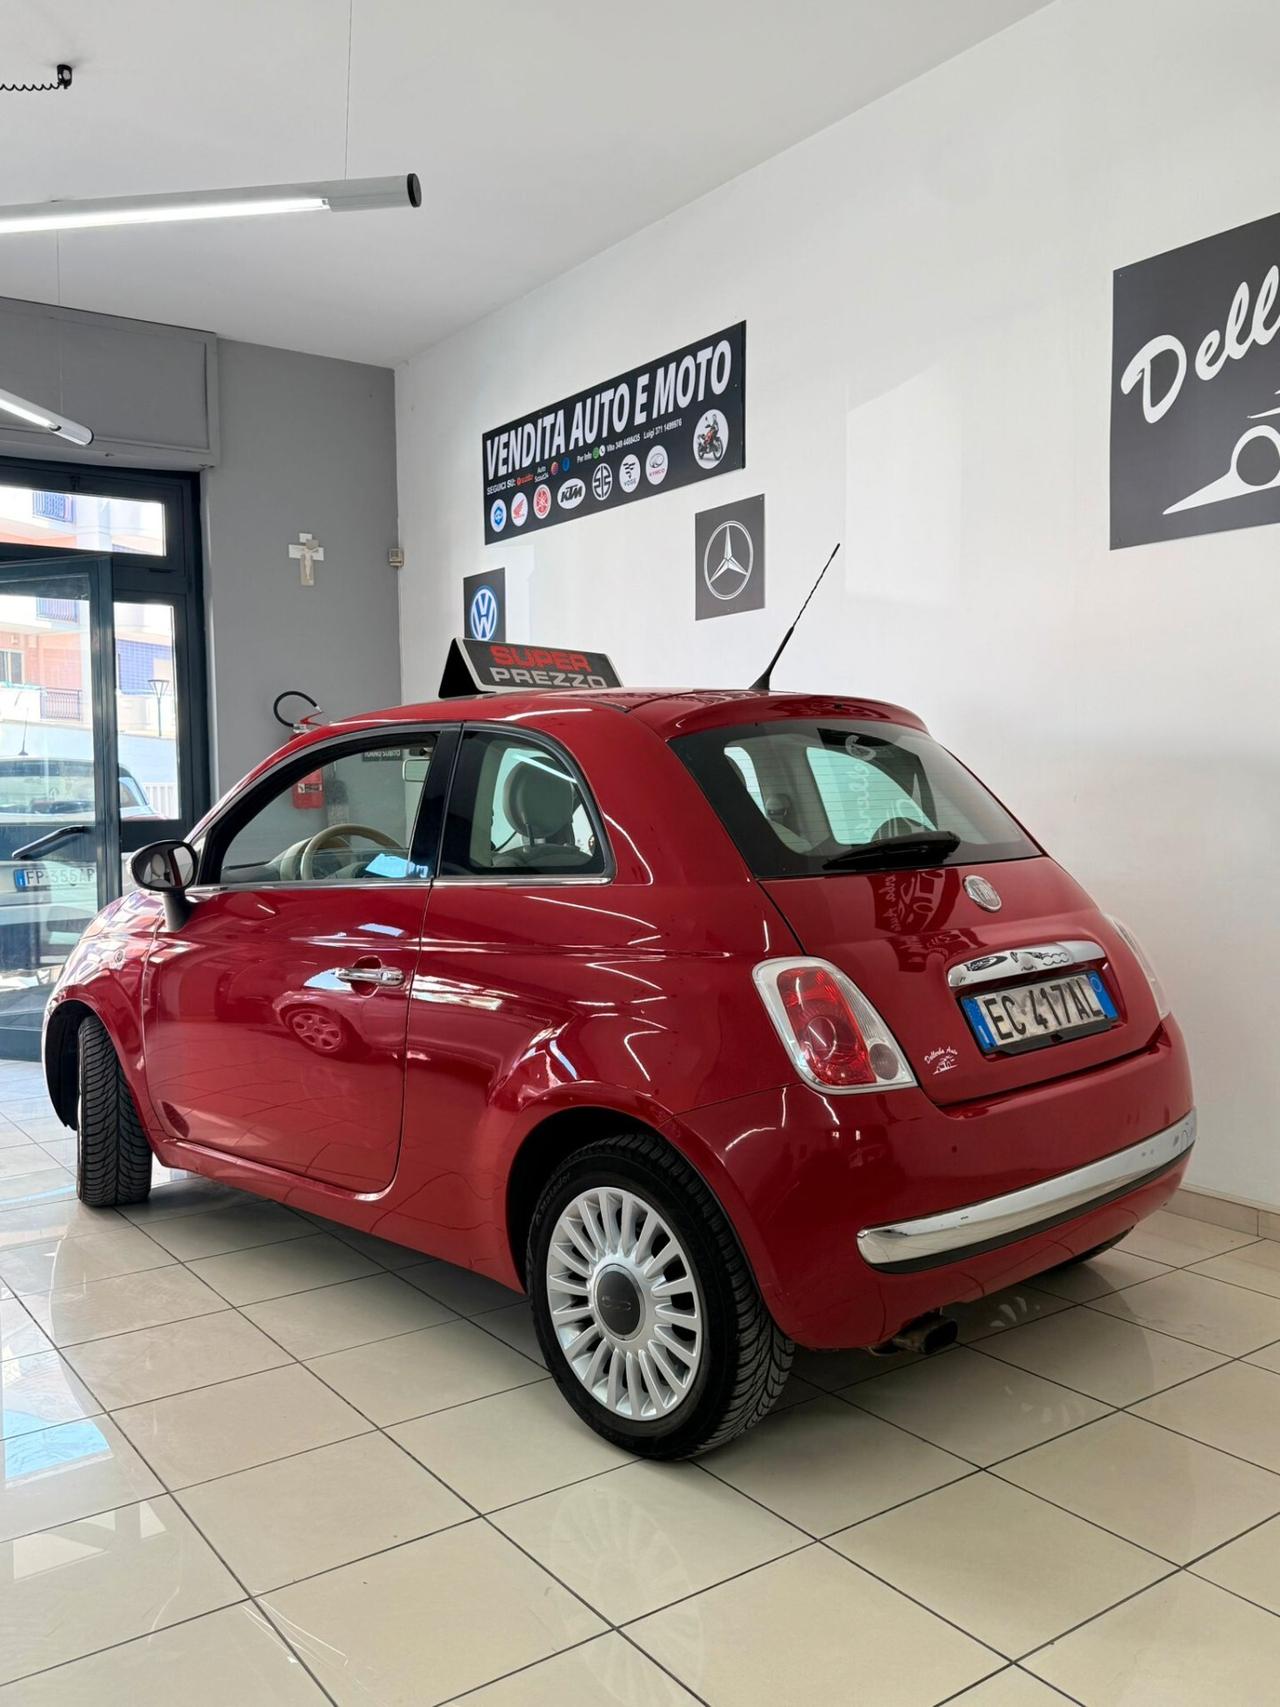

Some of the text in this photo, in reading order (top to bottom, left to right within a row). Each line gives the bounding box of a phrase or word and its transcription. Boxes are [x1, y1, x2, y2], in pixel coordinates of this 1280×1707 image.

[1120, 264, 1280, 424] Dell
[487, 339, 732, 481] VENDITA AUTO E MOTO
[643, 429, 655, 439] Luigi
[486, 481, 507, 496] SEGUICI
[560, 484, 583, 503] KTM
[489, 645, 592, 673] SUPER
[489, 667, 608, 689] PREZZO
[26, 870, 44, 885] FP
[983, 976, 1101, 1041] EC 417AL
